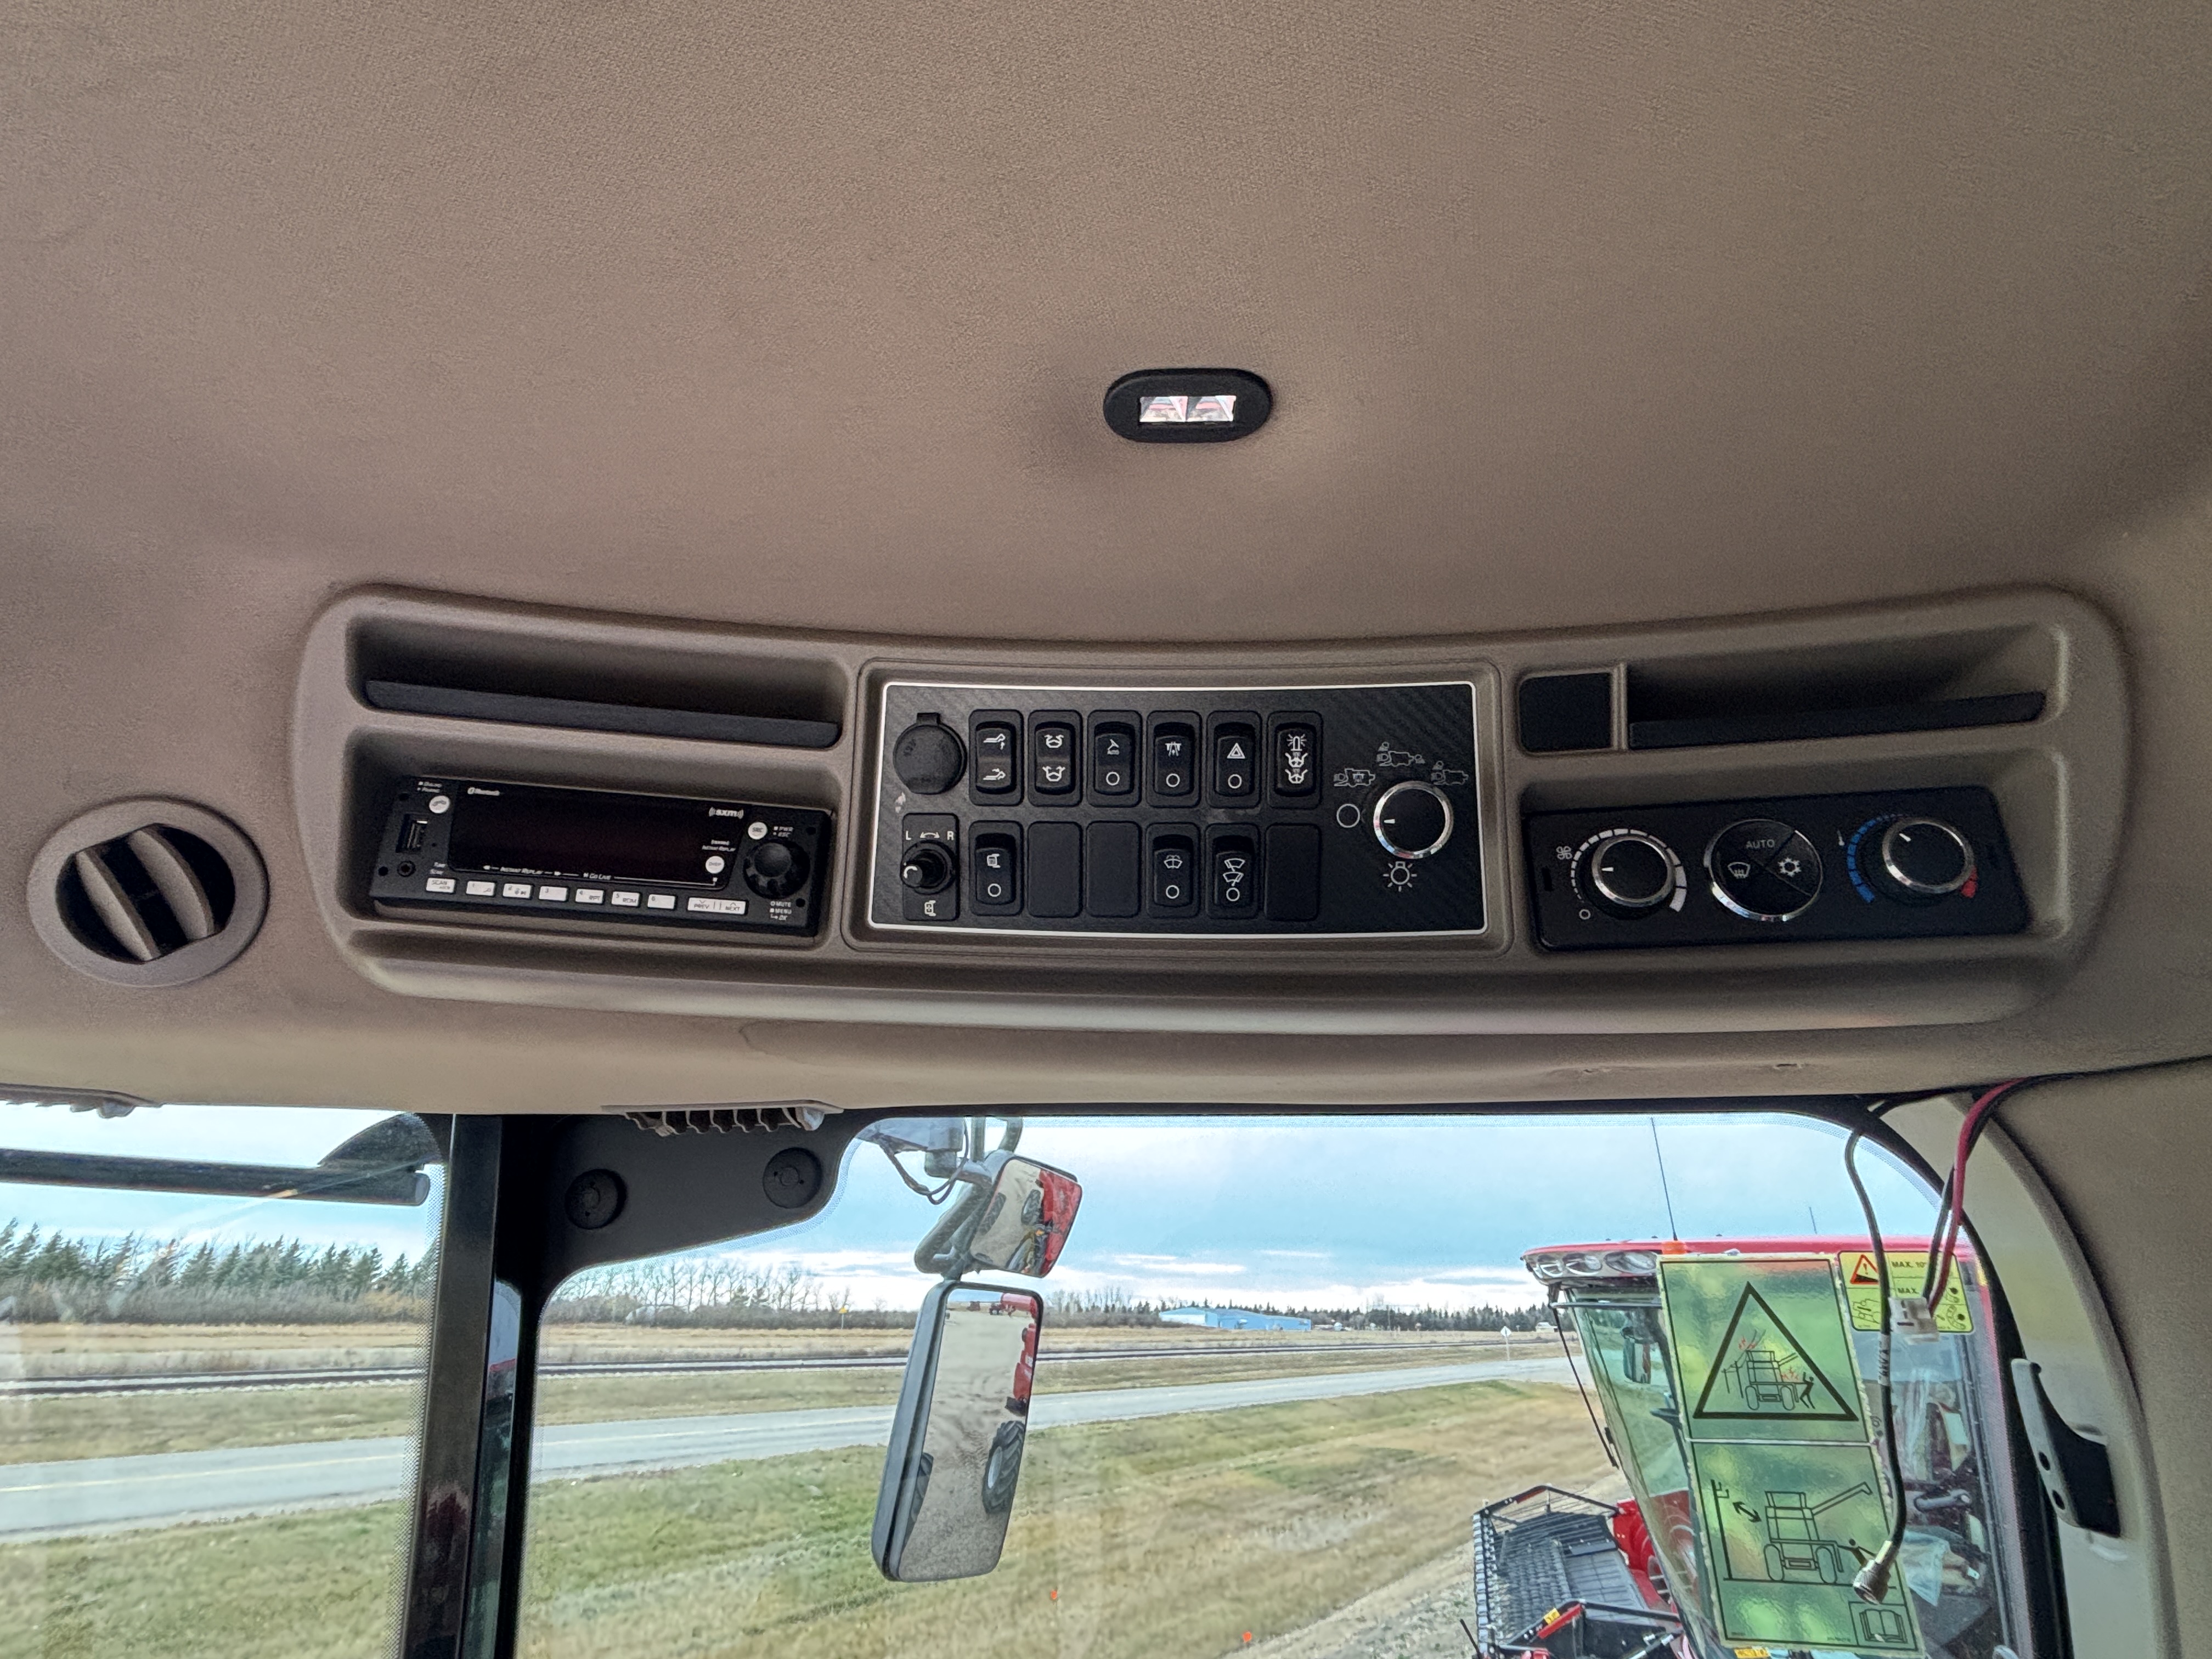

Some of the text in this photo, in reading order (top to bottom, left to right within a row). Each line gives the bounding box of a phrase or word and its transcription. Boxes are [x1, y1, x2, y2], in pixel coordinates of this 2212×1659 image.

[905, 830, 955, 841] L R
[1745, 839, 1775, 849] AUTO
